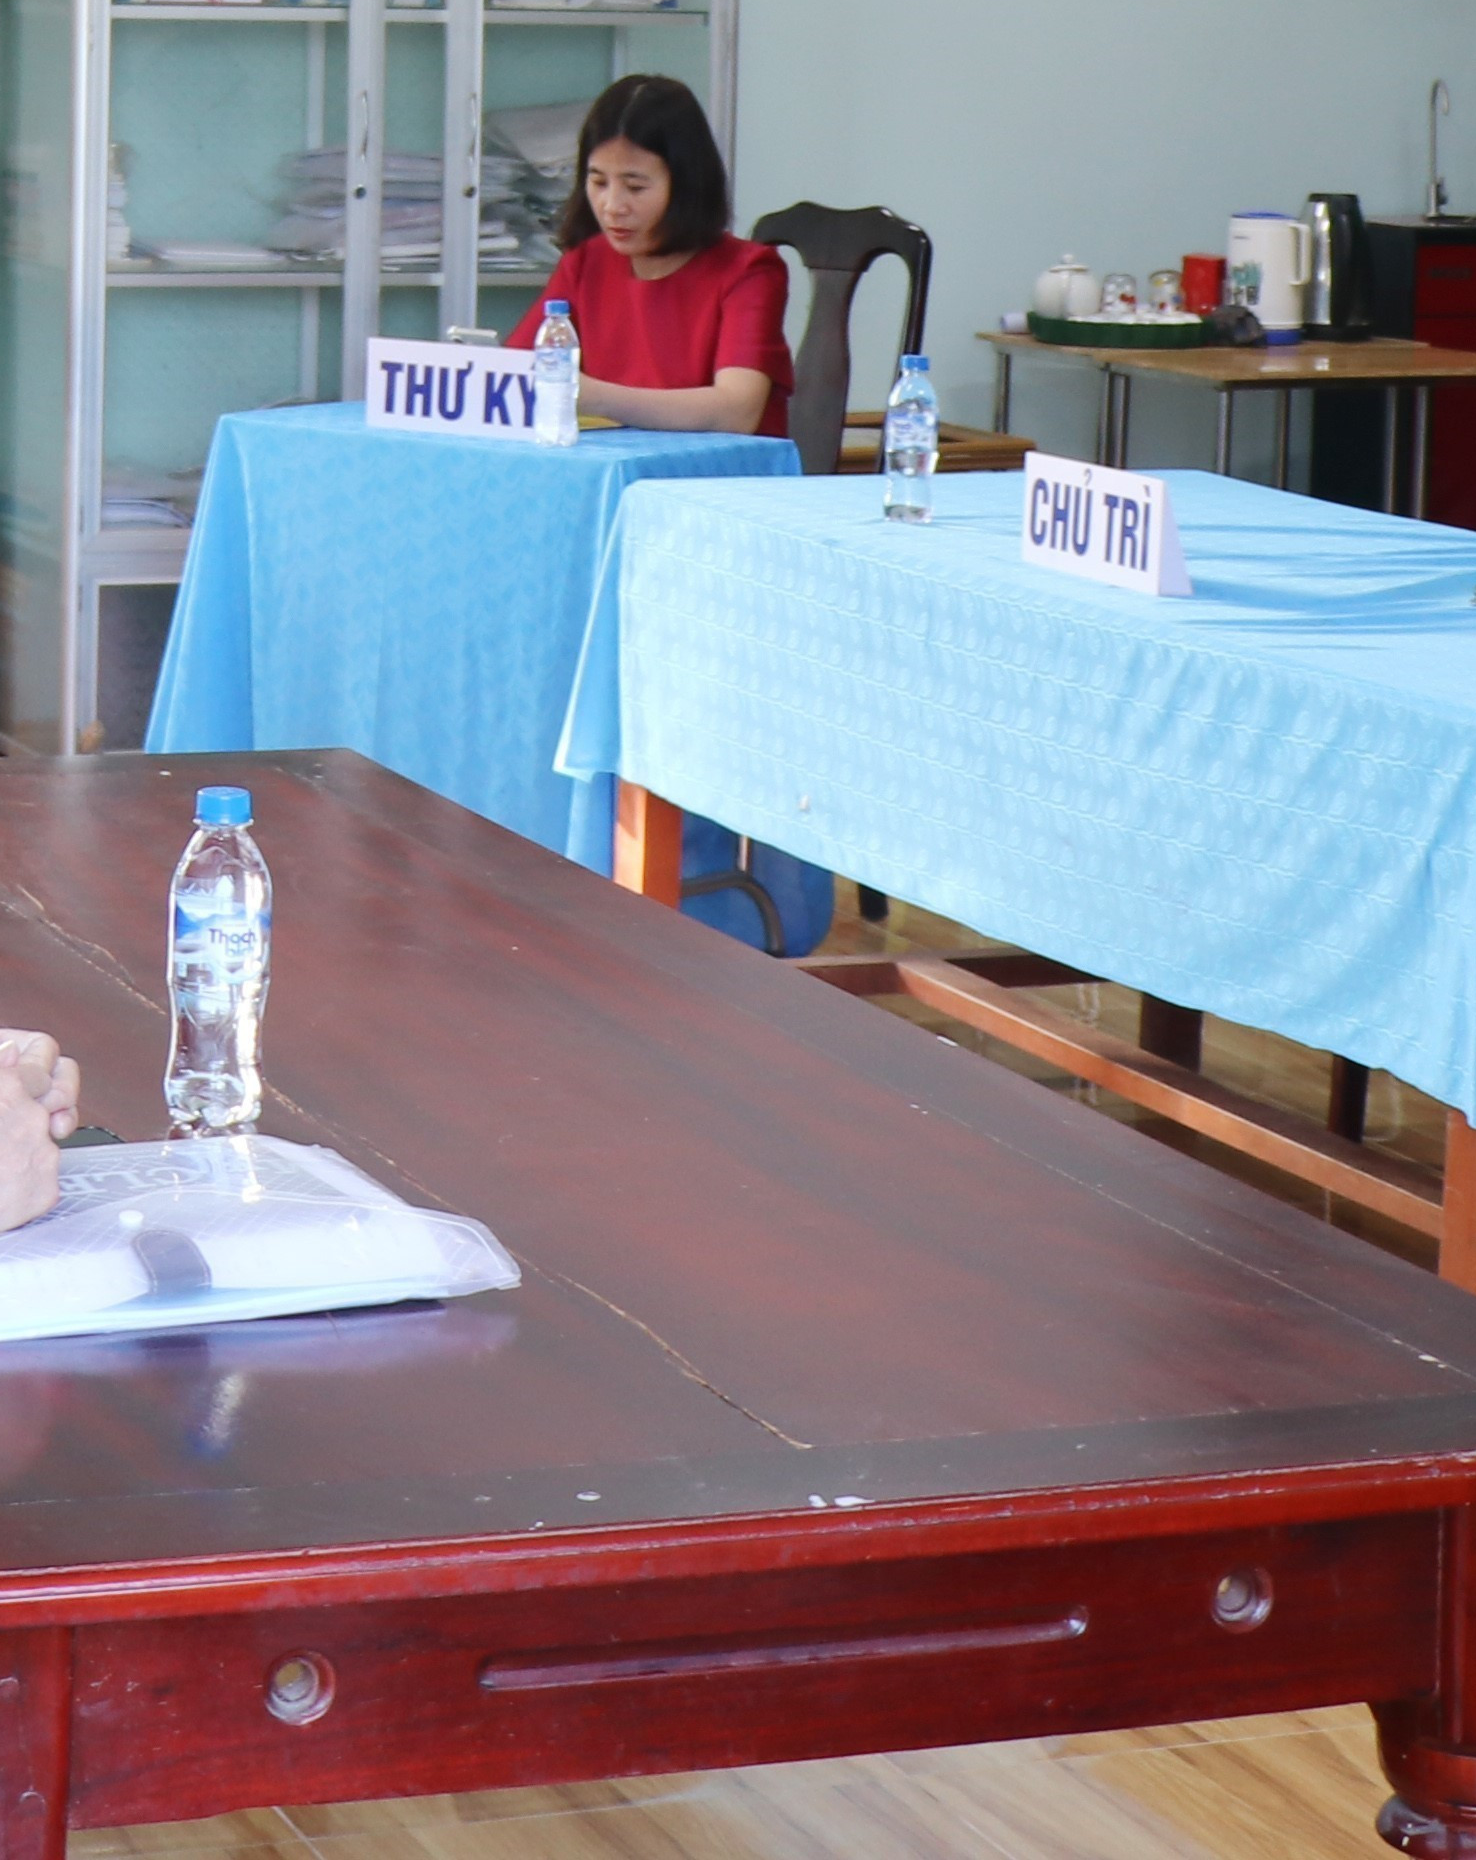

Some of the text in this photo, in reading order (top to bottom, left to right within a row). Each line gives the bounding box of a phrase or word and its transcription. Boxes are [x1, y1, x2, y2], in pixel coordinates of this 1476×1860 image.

[380, 360, 475, 421] THƯ
[1029, 467, 1153, 573] CHỦ TRÌ
